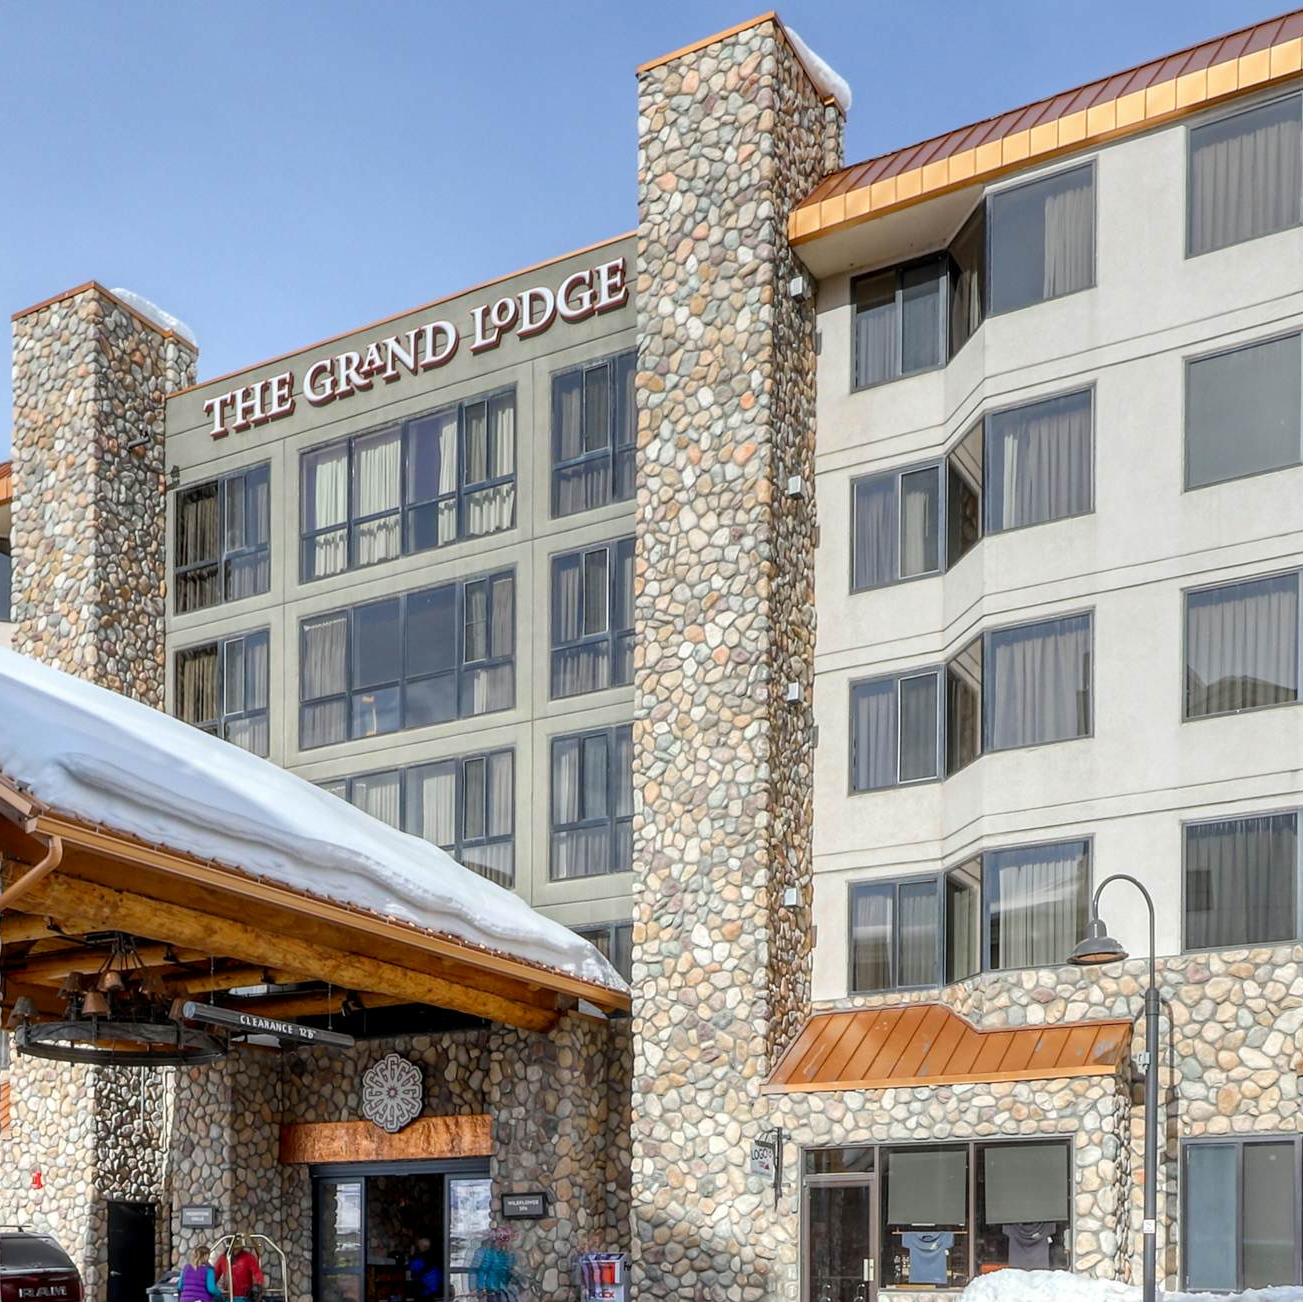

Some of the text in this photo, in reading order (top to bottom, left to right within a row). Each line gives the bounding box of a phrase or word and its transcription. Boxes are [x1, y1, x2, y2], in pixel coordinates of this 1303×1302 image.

[203, 257, 627, 438] THE GRAND LODGE
[240, 1015, 293, 1034] CLEARANCE
[19, 1286, 67, 1298] RAM
